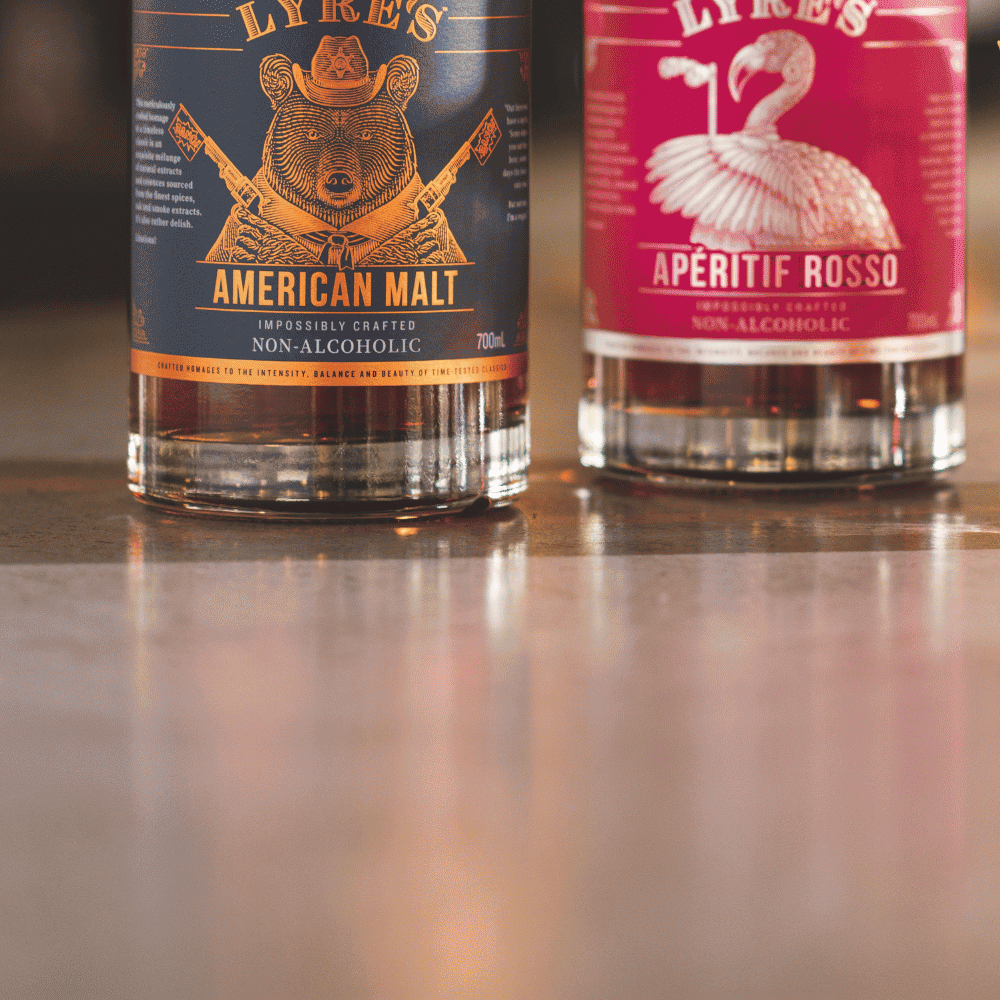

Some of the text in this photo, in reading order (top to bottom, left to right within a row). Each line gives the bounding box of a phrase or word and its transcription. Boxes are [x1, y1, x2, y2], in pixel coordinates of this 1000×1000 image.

[166, 181, 193, 190] sourced
[171, 193, 195, 204] spices,
[171, 207, 202, 216] extracts.
[170, 218, 193, 229] delish.
[653, 246, 898, 288] APÉRITIF ROSSO
[213, 268, 459, 307] AMERICAN MALT
[258, 319, 416, 332] IMPOSSIBLY CRAFTED
[691, 315, 850, 333] NON-ALCOHOLIC
[252, 337, 421, 354] NON-ALCOHOLIC
[476, 331, 506, 350] 700mL
[157, 362, 183, 372] CRAFTED
[187, 365, 221, 375] HOMAGES
[224, 367, 234, 376] TO
[238, 368, 253, 377] THE
[257, 369, 309, 379] INTENSITY,
[313, 370, 355, 379] BALANCE
[359, 370, 377, 379] AND
[381, 369, 415, 378] BEAUTY
[418, 368, 428, 377] OF
